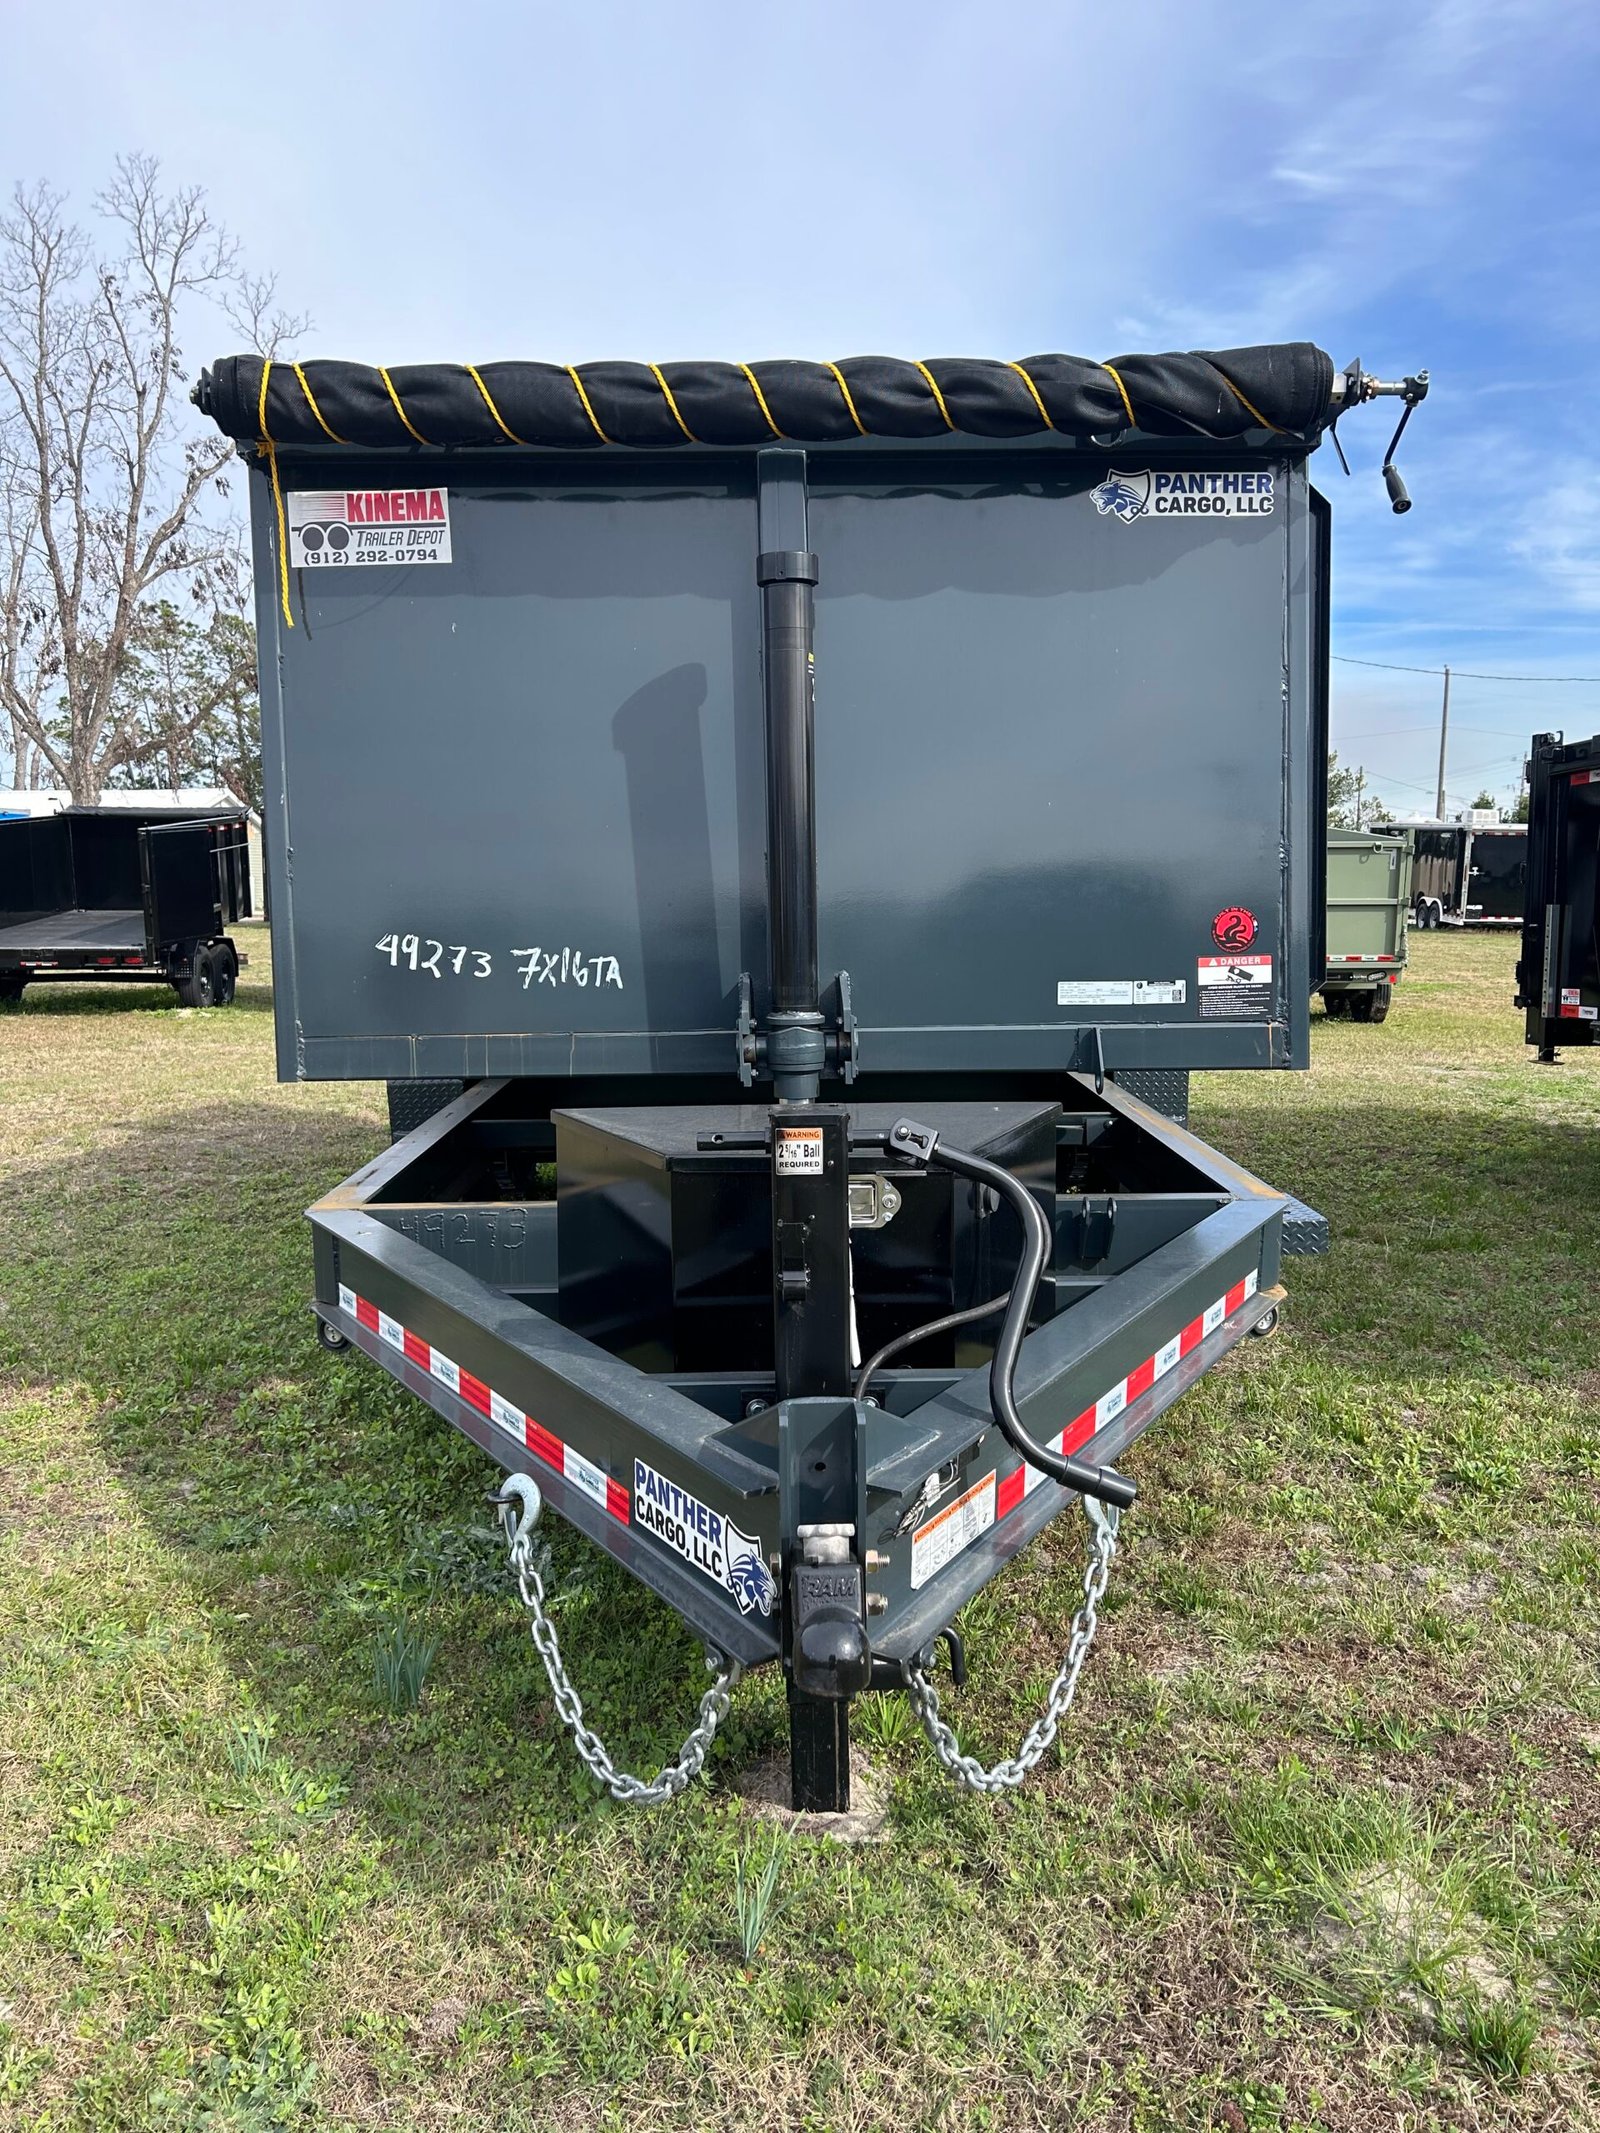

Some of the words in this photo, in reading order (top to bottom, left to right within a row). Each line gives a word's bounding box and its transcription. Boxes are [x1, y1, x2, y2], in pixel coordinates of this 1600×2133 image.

[1155, 474, 1273, 494] PANTHER
[346, 490, 445, 522] KINEMA
[1155, 497, 1231, 516] CARGO,
[1236, 497, 1273, 513] LLC
[357, 530, 404, 547] TRAILER
[407, 529, 445, 546] DEPOT
[304, 551, 349, 565] (912)
[356, 549, 438, 563] 292-0794
[375, 932, 492, 979] 49273
[1220, 957, 1261, 966] DANGER
[785, 1131, 820, 1139] WARNING
[803, 1143, 820, 1158] Ball
[400, 1207, 528, 1249] 49273
[635, 1461, 722, 1548] PANTHER
[636, 1496, 691, 1558] CARGO,
[693, 1536, 722, 1578] LLC
